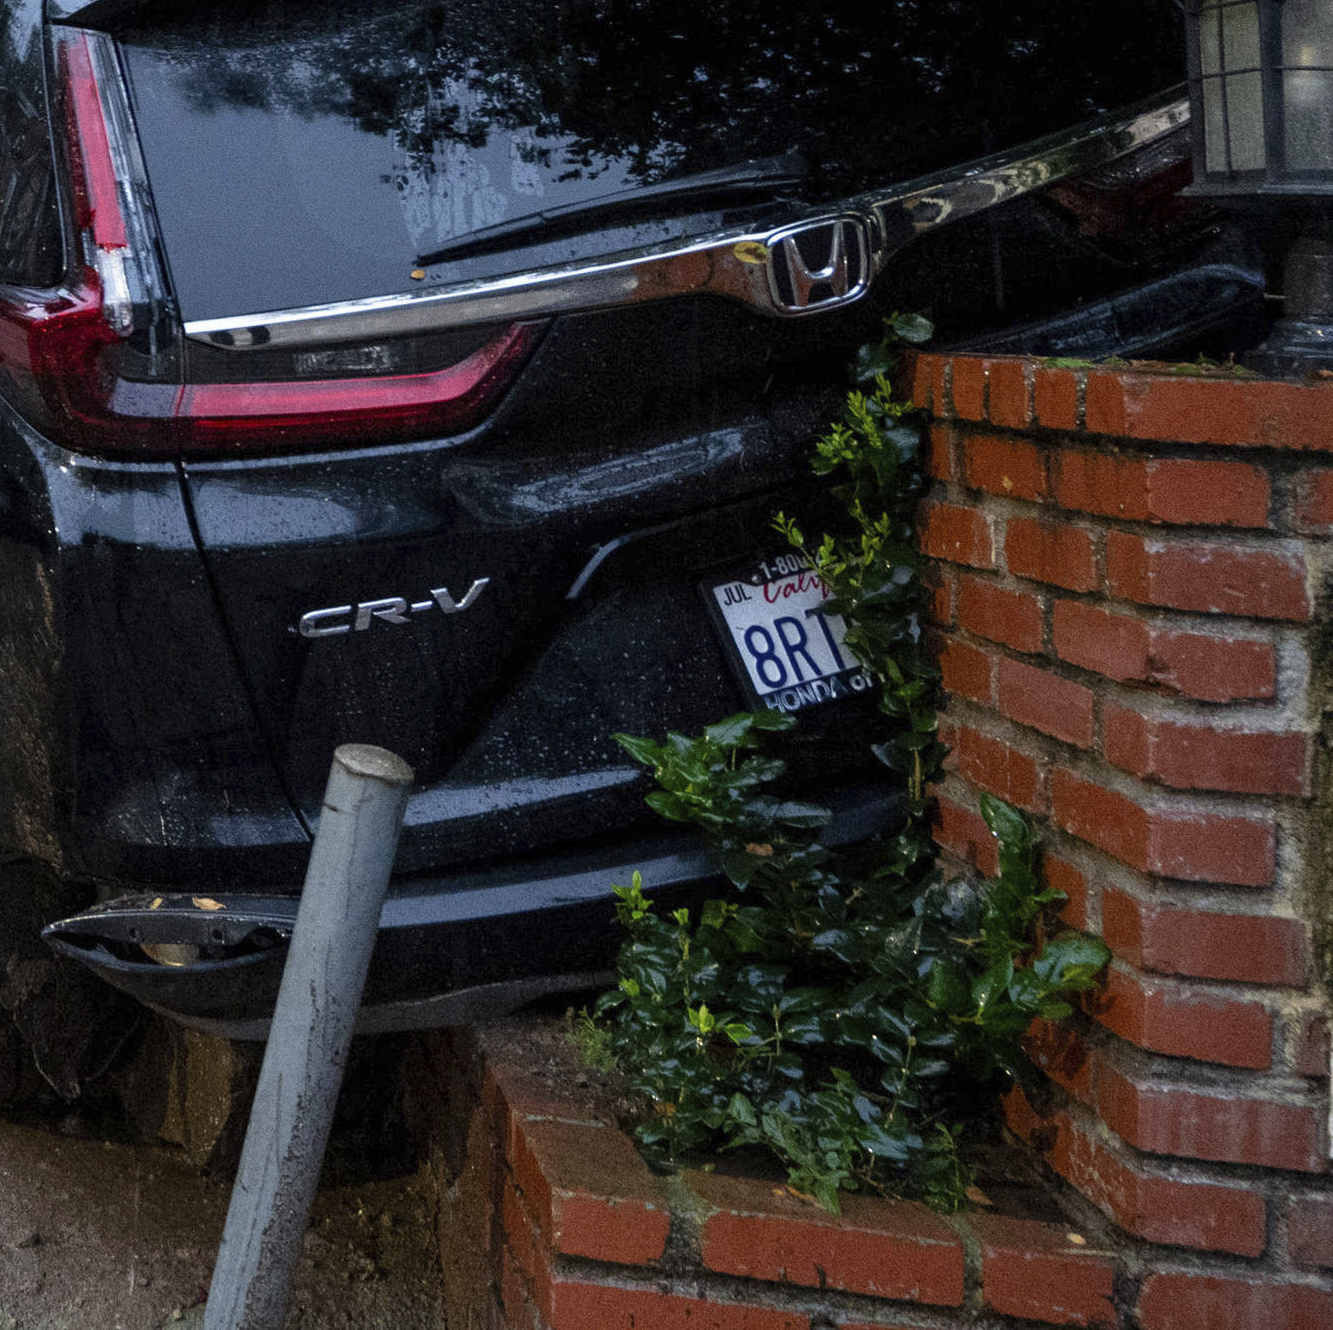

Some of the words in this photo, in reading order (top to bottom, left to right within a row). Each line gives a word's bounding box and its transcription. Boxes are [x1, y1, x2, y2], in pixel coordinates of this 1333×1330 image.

[299, 577, 491, 638] CR-V
[723, 584, 753, 607] JUL
[743, 609, 847, 689] 8RT
[764, 675, 848, 713] HONDA
